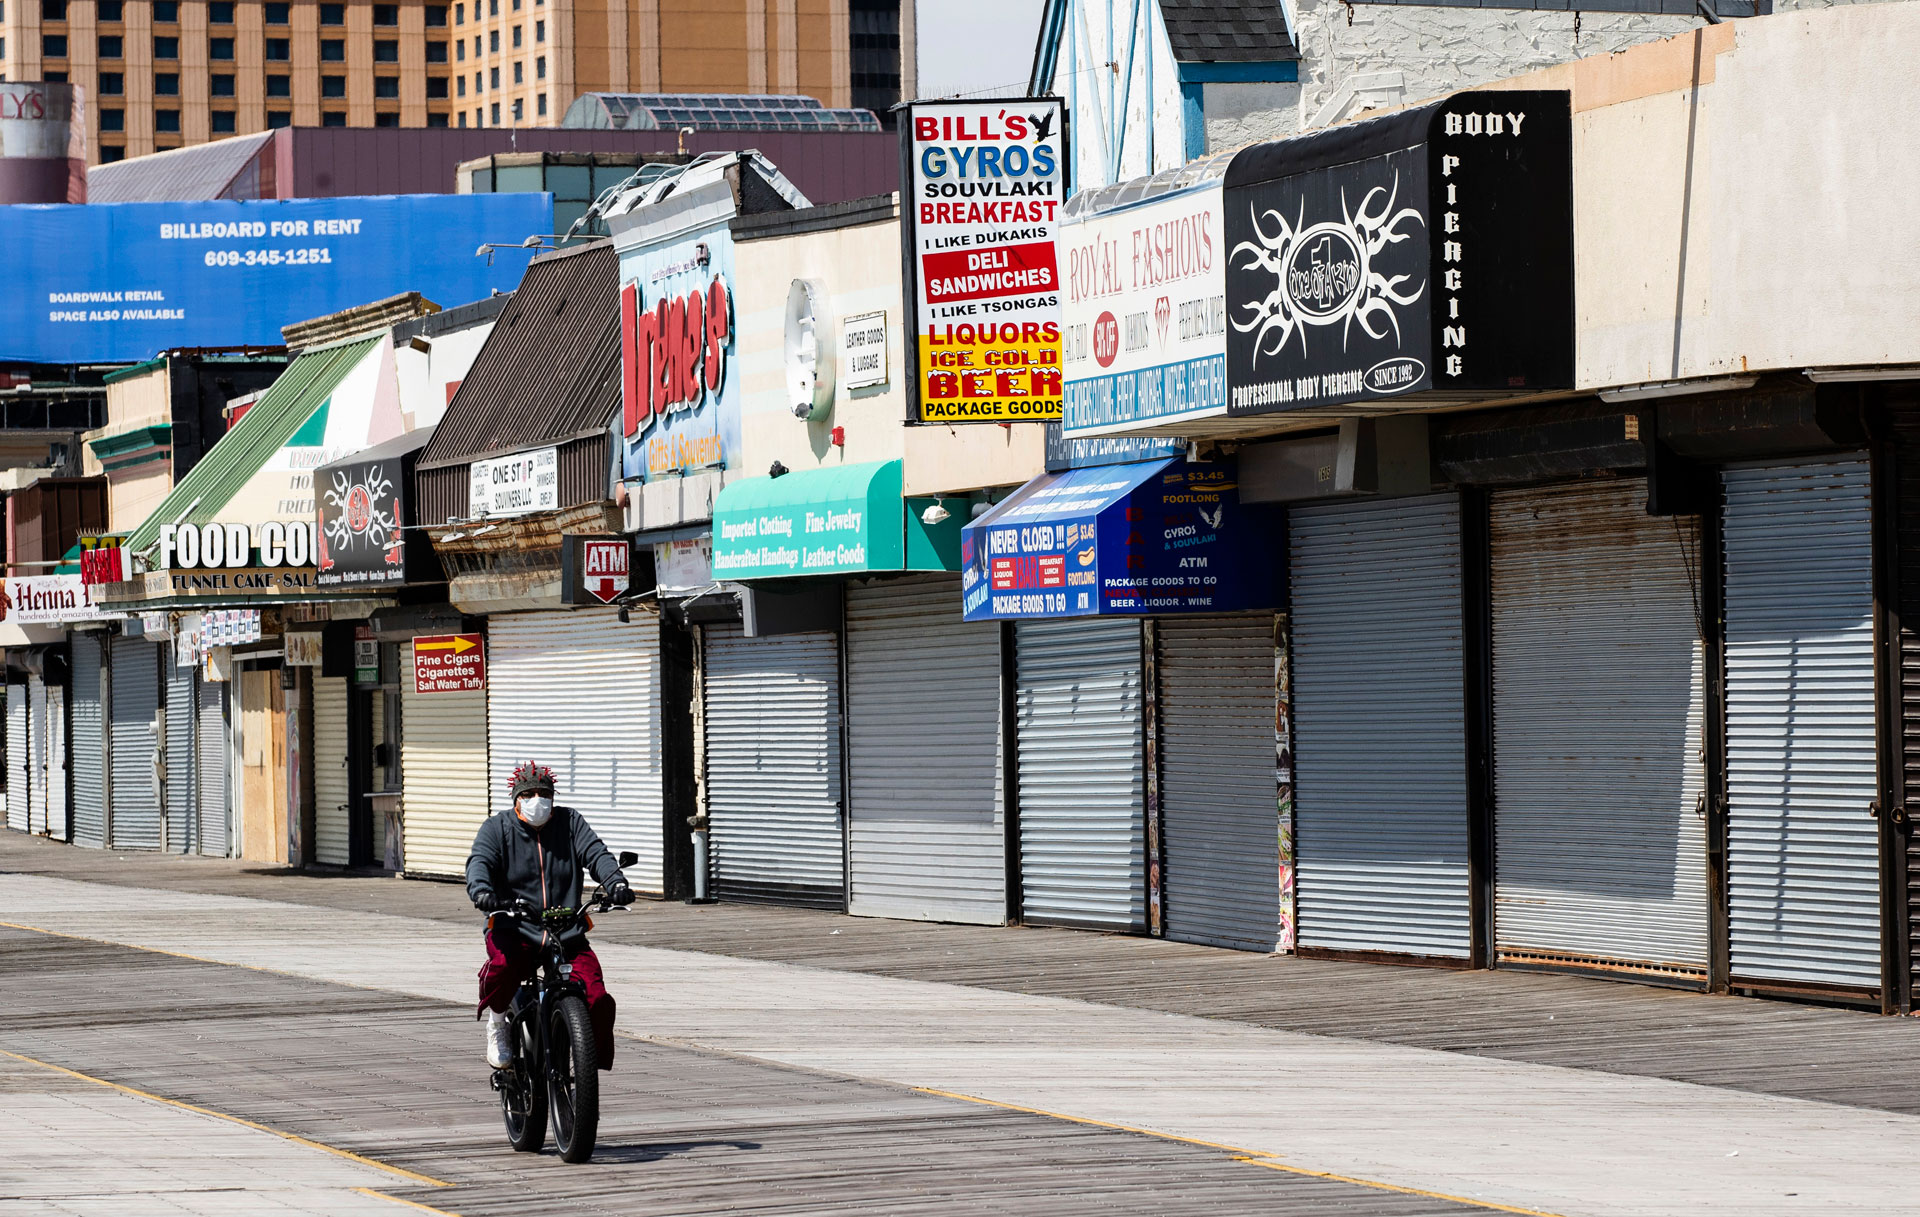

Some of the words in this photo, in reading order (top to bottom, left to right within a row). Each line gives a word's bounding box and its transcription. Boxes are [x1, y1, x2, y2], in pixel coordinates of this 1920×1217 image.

[915, 109, 1027, 141] BILL'S
[1444, 111, 1526, 137] BODY
[921, 145, 1055, 179] GYROS
[924, 181, 1053, 198] SOUVLAKI
[920, 200, 1058, 224] BREAKFAST
[160, 222, 266, 239] BILLBOARD
[271, 220, 308, 237] FOR
[314, 218, 362, 235] RENT
[925, 239, 929, 249] I
[935, 235, 971, 248] LIKE
[975, 227, 1047, 244] DUKAKIS
[204, 248, 331, 267] 609-345-1251
[967, 250, 1009, 271] DELI
[1070, 233, 1123, 304] ROYAL
[1132, 210, 1212, 292] FASHIONS
[1442, 154, 1466, 377] PIERCING
[930, 267, 1051, 296] SANDWICHES
[49, 291, 123, 303] BOARDWALK
[125, 290, 164, 302] RETAIL
[931, 308, 936, 318] I
[942, 304, 977, 317] LIKE
[981, 296, 1058, 314] TSONGAS
[49, 311, 87, 322] SPACE
[89, 310, 120, 321] ALSO
[122, 308, 185, 320] AVAILABLE
[846, 331, 866, 349] LEATHER
[866, 327, 884, 345] GOODS
[928, 321, 1060, 346] LIQUORS
[857, 353, 879, 371] LUGGAGE
[930, 350, 974, 367] ICE
[984, 348, 1057, 366] COLD
[927, 366, 1062, 399] BEER
[1374, 365, 1397, 387] SINCE
[1398, 364, 1413, 383] 1992
[1232, 379, 1294, 408] PROFESSIONAL
[1296, 374, 1320, 401] BODY
[1322, 369, 1363, 398] PIERCING
[926, 401, 1002, 416] PACKAGE
[1008, 400, 1062, 415] GOODS
[649, 438, 668, 472] Gifts
[679, 428, 722, 468] Souvenirs
[493, 465, 508, 485] ONE
[1187, 471, 1225, 481] $3.45
[1163, 494, 1220, 504] FOOTLONG
[721, 518, 757, 542] Imported
[759, 516, 792, 538] Clothing
[805, 512, 824, 533] Fine
[825, 508, 862, 534] Jewelry
[1163, 525, 1196, 540] GYROS
[160, 523, 250, 569] FOOD
[990, 529, 1018, 554] NEVER
[1021, 526, 1054, 552] CLOSED
[1173, 533, 1217, 549] SOUVLAKI
[587, 546, 626, 572] ATM
[714, 548, 761, 569] Handcrafted
[761, 547, 799, 569] Handbags
[802, 547, 836, 568] Leather
[836, 543, 865, 565] Goods
[1039, 558, 1063, 566] BREAKFAST
[1178, 557, 1208, 568] ATM
[172, 573, 231, 590] FUNNEL
[234, 573, 274, 589] CAKE
[1017, 556, 1037, 589] BAR
[1067, 571, 1096, 586] FOOTLONG
[1105, 577, 1149, 587] PACKAGE
[1151, 577, 1184, 586] GOODS
[1187, 576, 1200, 584] TO
[1203, 576, 1217, 585] GO
[14, 583, 76, 611] Henna
[992, 595, 1021, 614] PACKAGE
[1022, 594, 1044, 613] GOODS
[1045, 594, 1055, 612] TO
[1056, 593, 1066, 612] GO
[1077, 592, 1089, 609] ATM
[1110, 599, 1135, 607] BEER
[1144, 598, 1179, 607] LIQUOR
[1188, 598, 1213, 606] WINE
[18, 611, 51, 621] hundreds
[52, 610, 60, 619] of
[62, 611, 93, 620] amazing
[417, 655, 441, 666] Fine
[444, 653, 480, 667] Cigars
[417, 665, 475, 679] Cigarettes
[418, 680, 435, 691] Salt
[437, 679, 460, 690] Water
[462, 677, 484, 691] Taffy
